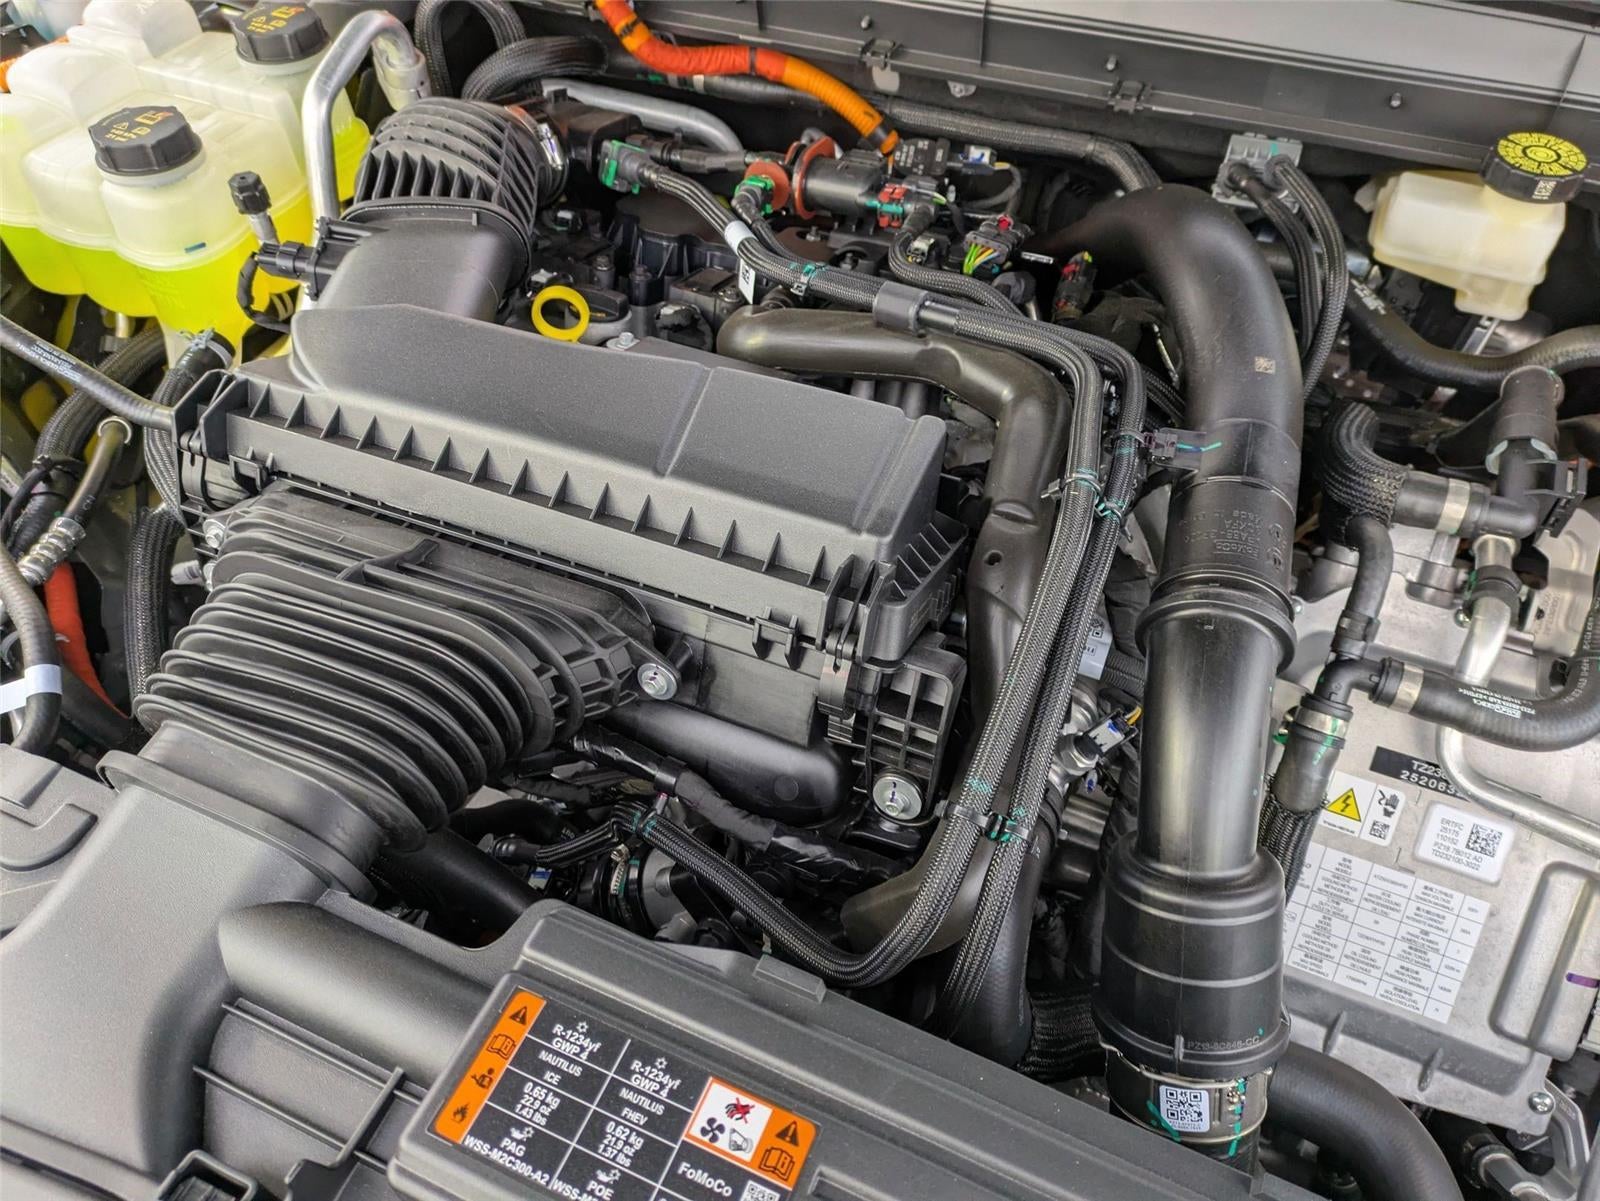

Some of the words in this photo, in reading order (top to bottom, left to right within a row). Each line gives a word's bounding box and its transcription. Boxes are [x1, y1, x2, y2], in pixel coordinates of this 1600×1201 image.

[552, 1023, 602, 1052] R-1234yf
[552, 1037, 580, 1055] GWP
[580, 1050, 589, 1060] 4
[538, 1049, 583, 1077] NAUTILUS
[630, 1059, 682, 1090] R-1234yf
[543, 1070, 562, 1086] ICE
[631, 1074, 660, 1093] GWP
[659, 1088, 669, 1098] 4
[520, 1094, 541, 1110] 22.9
[540, 1104, 552, 1116] oz
[523, 1082, 547, 1100] 0.65
[545, 1092, 560, 1110] kg
[619, 1087, 666, 1115] NAUTILUS
[515, 1103, 534, 1119] 1.43
[531, 1111, 547, 1126] lbs
[621, 1107, 648, 1126] FHEV
[500, 1137, 526, 1157] PAG
[602, 1134, 624, 1150] 21.9
[622, 1144, 636, 1157] oz
[605, 1121, 630, 1140] 0.62
[628, 1131, 644, 1150] kg
[464, 1134, 550, 1185] WSS-M2C300-A2
[597, 1143, 618, 1159] 1.37
[615, 1152, 632, 1167] lbs
[586, 1180, 614, 1201] POE
[677, 1161, 733, 1197] FoMoCo
